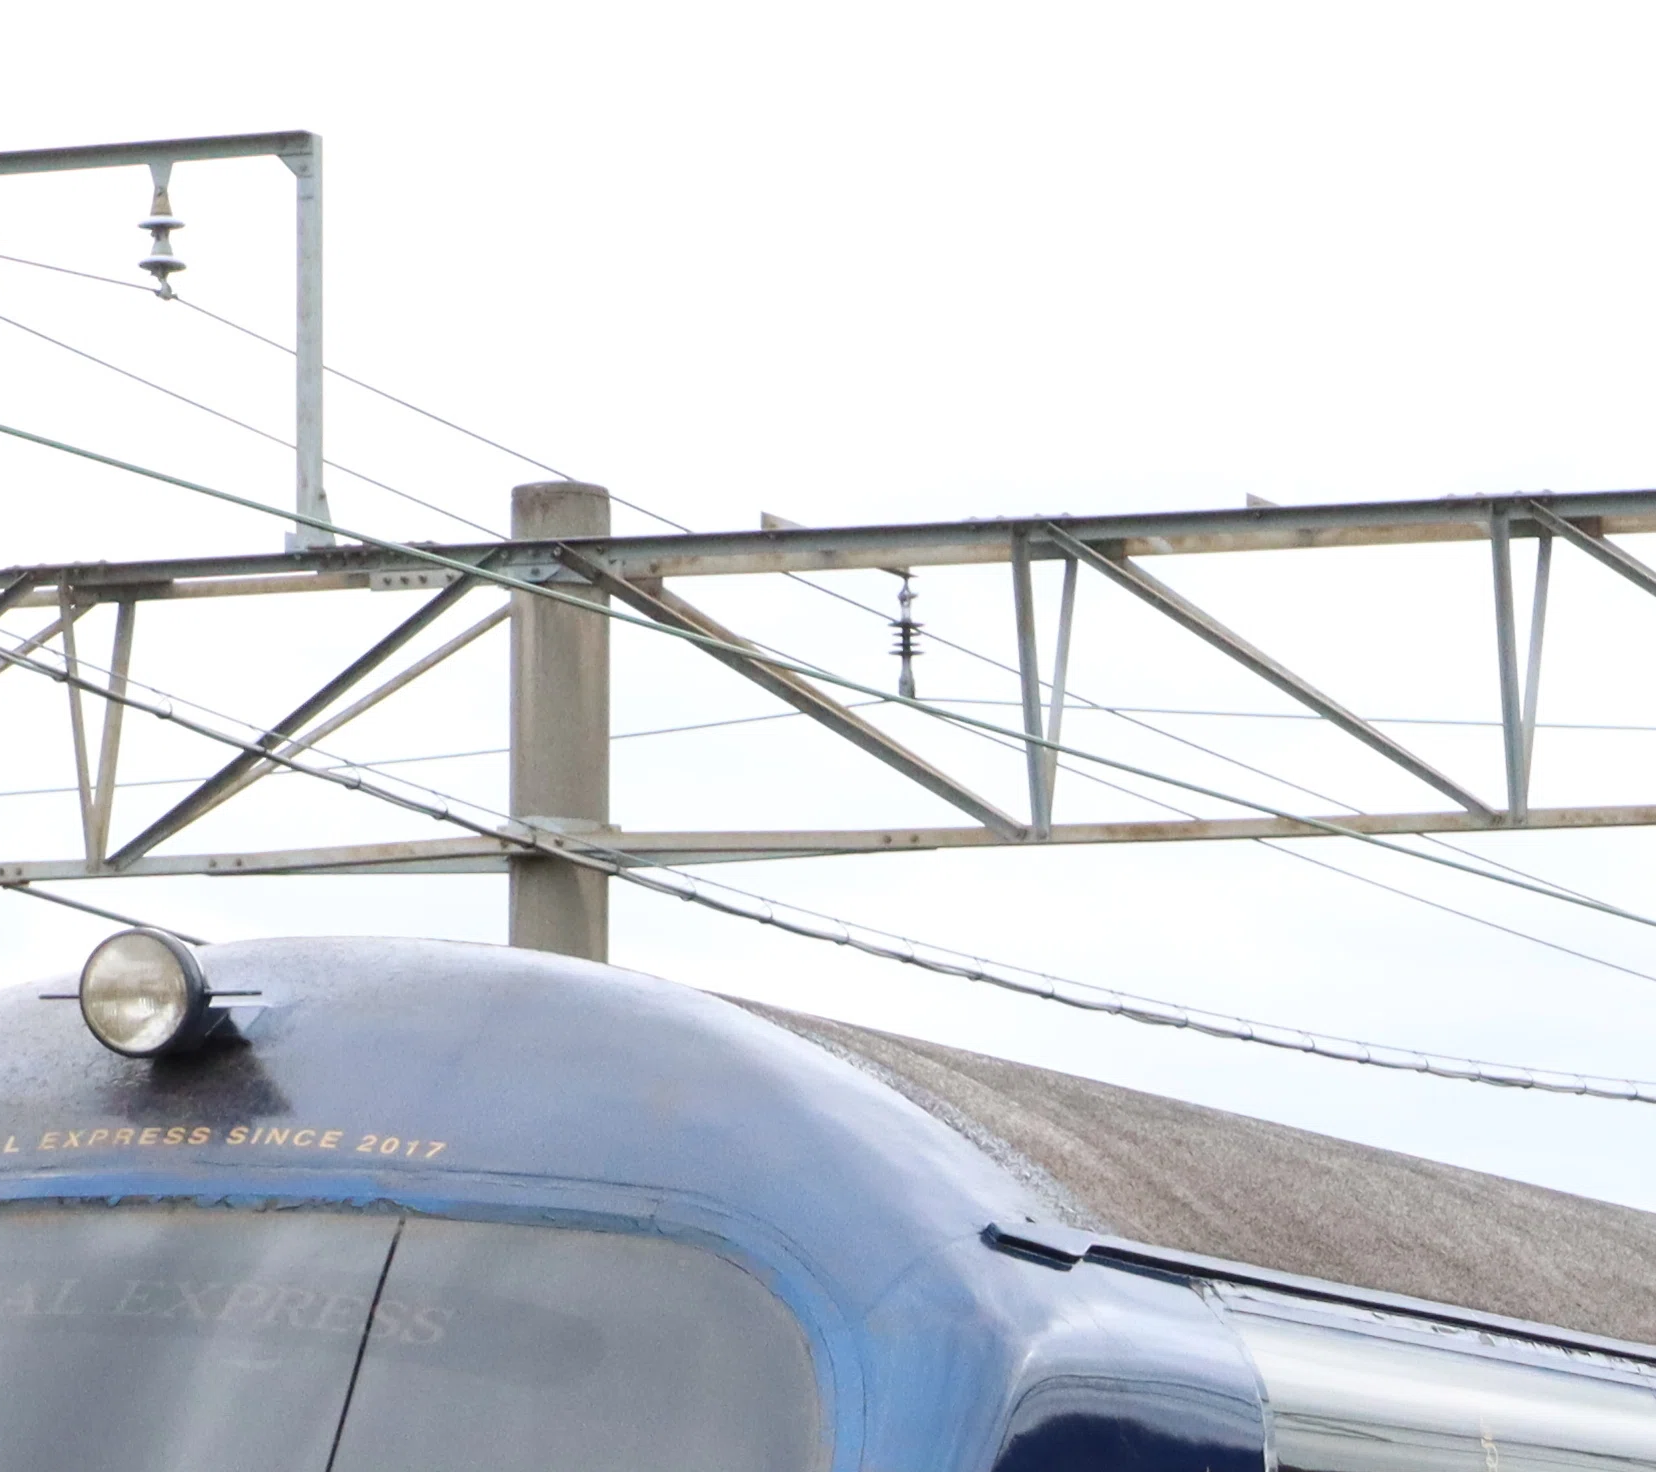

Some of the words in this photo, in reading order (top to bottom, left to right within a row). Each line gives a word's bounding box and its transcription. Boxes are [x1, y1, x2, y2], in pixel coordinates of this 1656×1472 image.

[41, 1126, 211, 1150] EXPRESS
[227, 1126, 343, 1149] SINCE
[357, 1135, 447, 1159] 2017
[116, 1279, 459, 1349] EXPRESS
